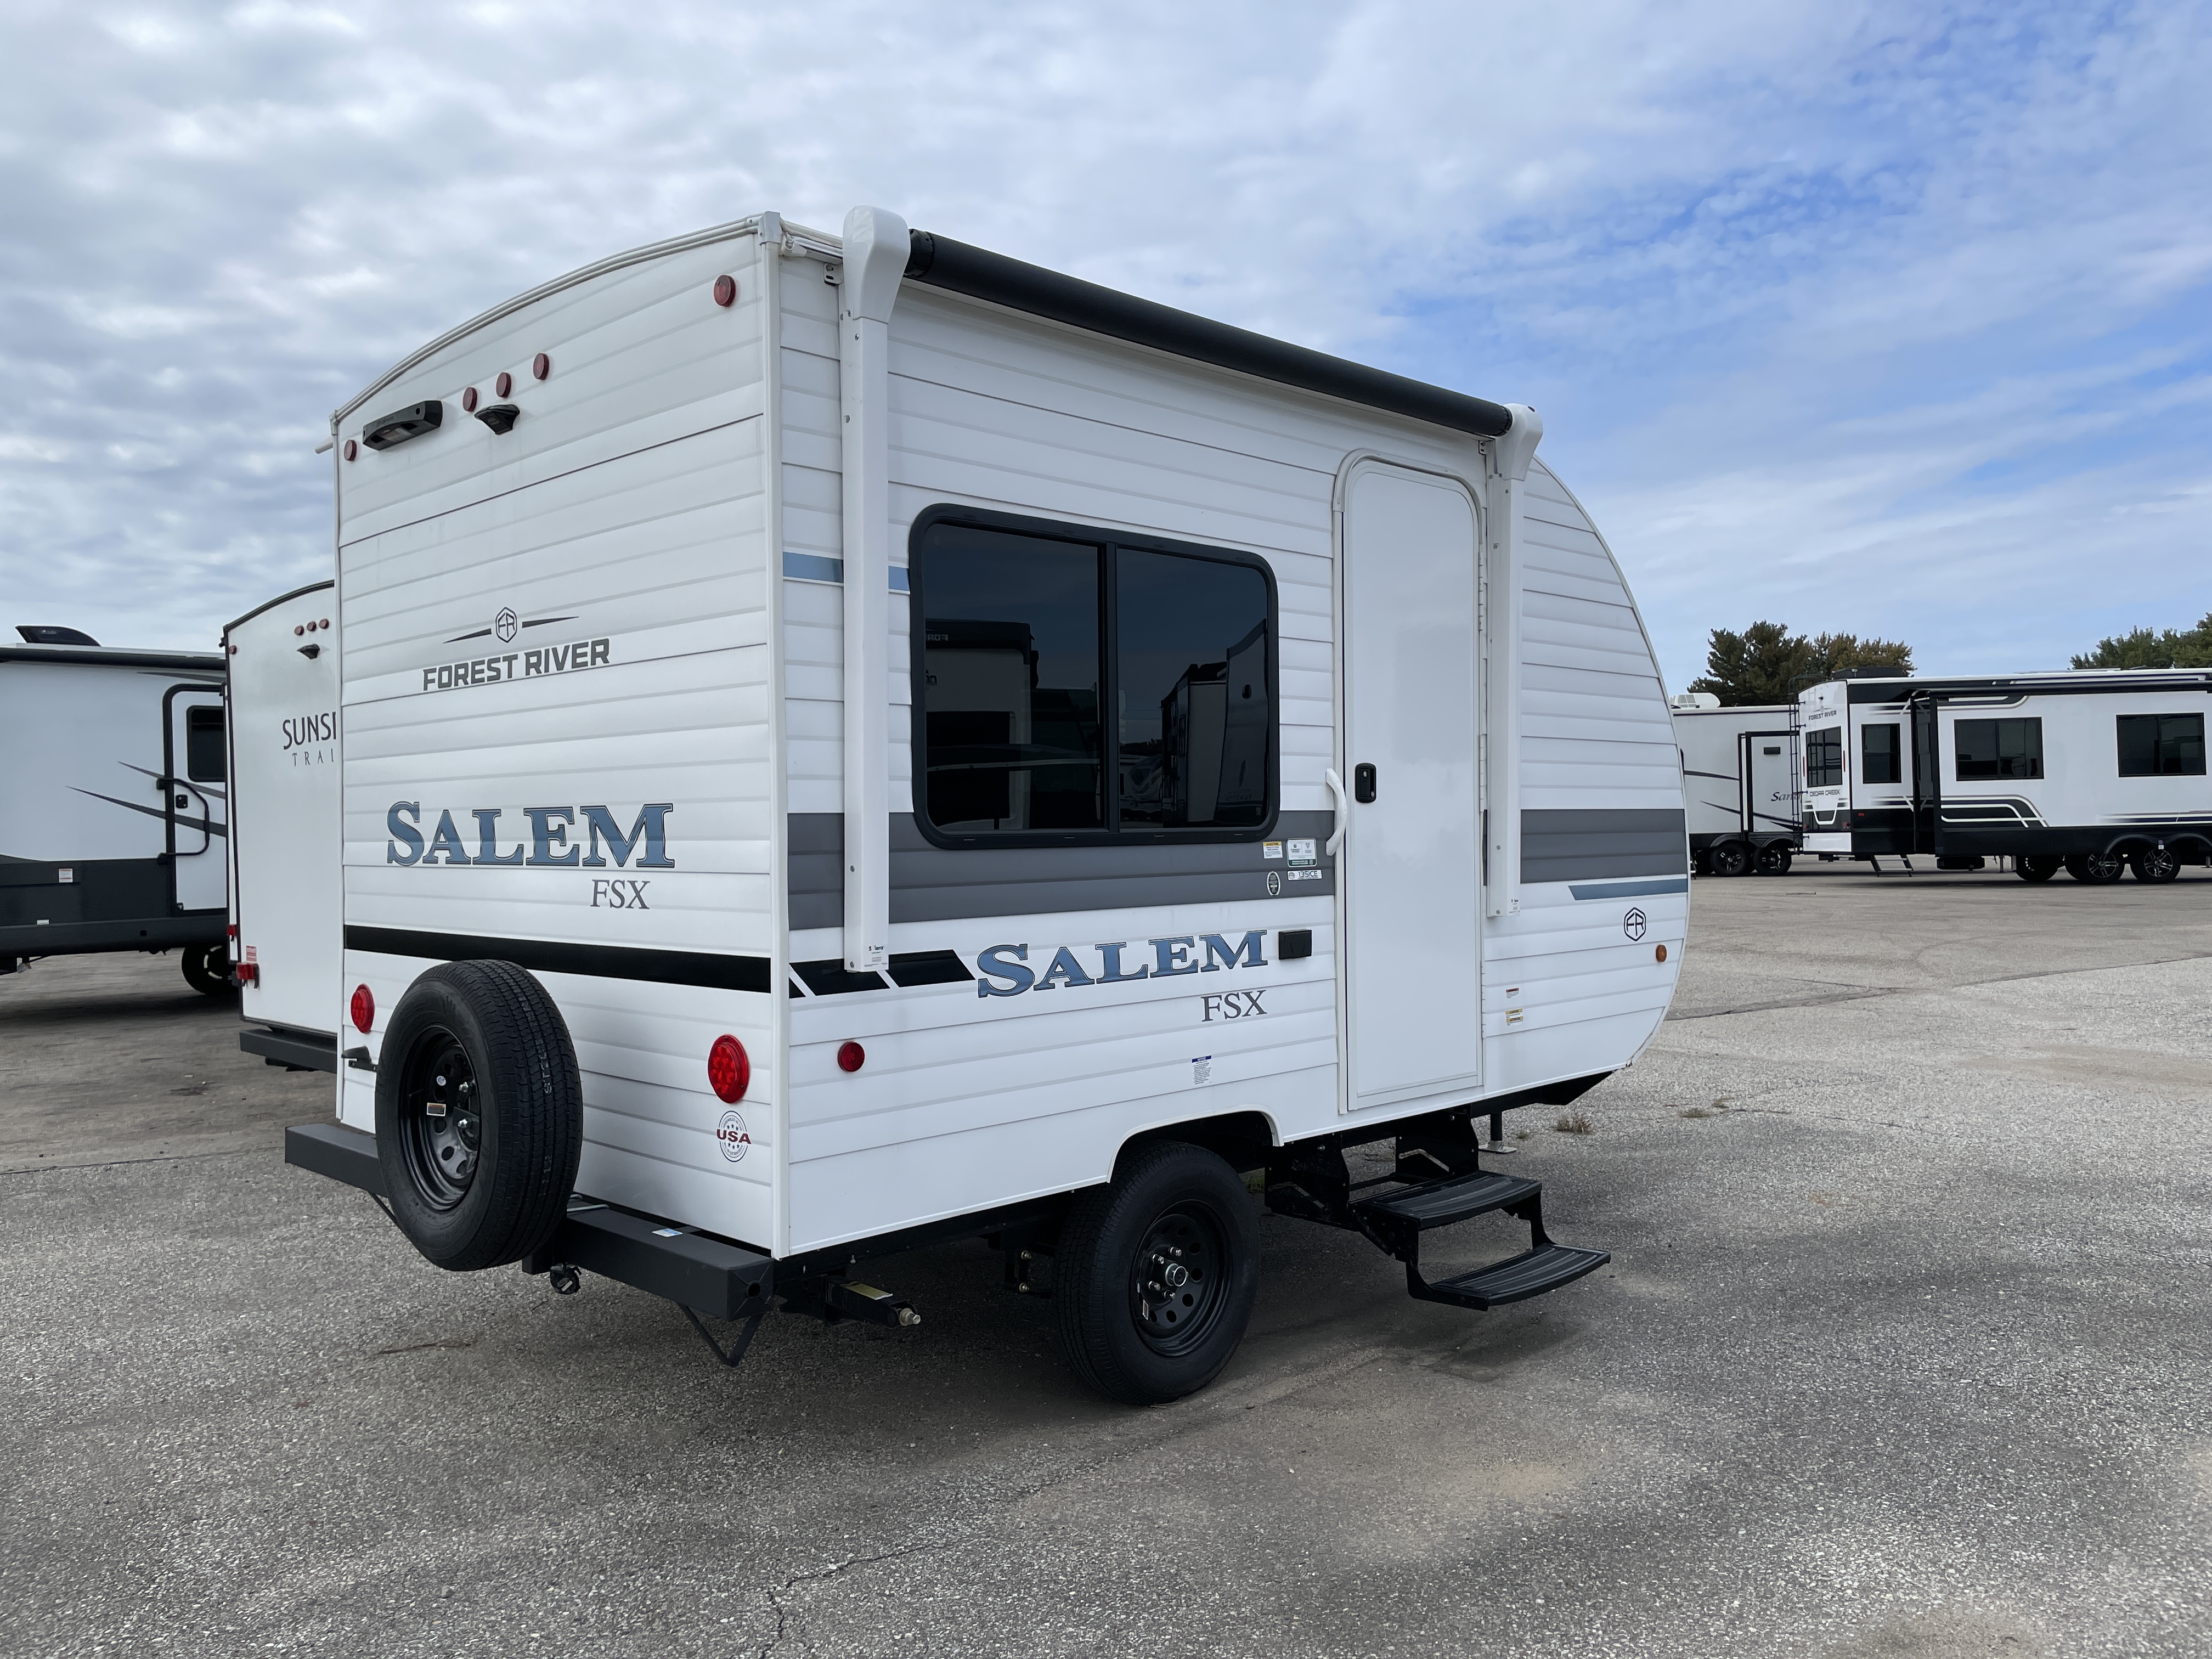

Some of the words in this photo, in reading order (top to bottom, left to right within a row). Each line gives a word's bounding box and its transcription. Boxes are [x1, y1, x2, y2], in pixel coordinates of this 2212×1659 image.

[424, 654, 518, 691] FOREST
[524, 638, 610, 675] RIVER
[386, 801, 675, 868] SALEM
[590, 879, 651, 910] FSX
[977, 929, 1268, 998] SALEM
[1200, 989, 1268, 1022] FSX
[716, 1128, 752, 1144] USA
